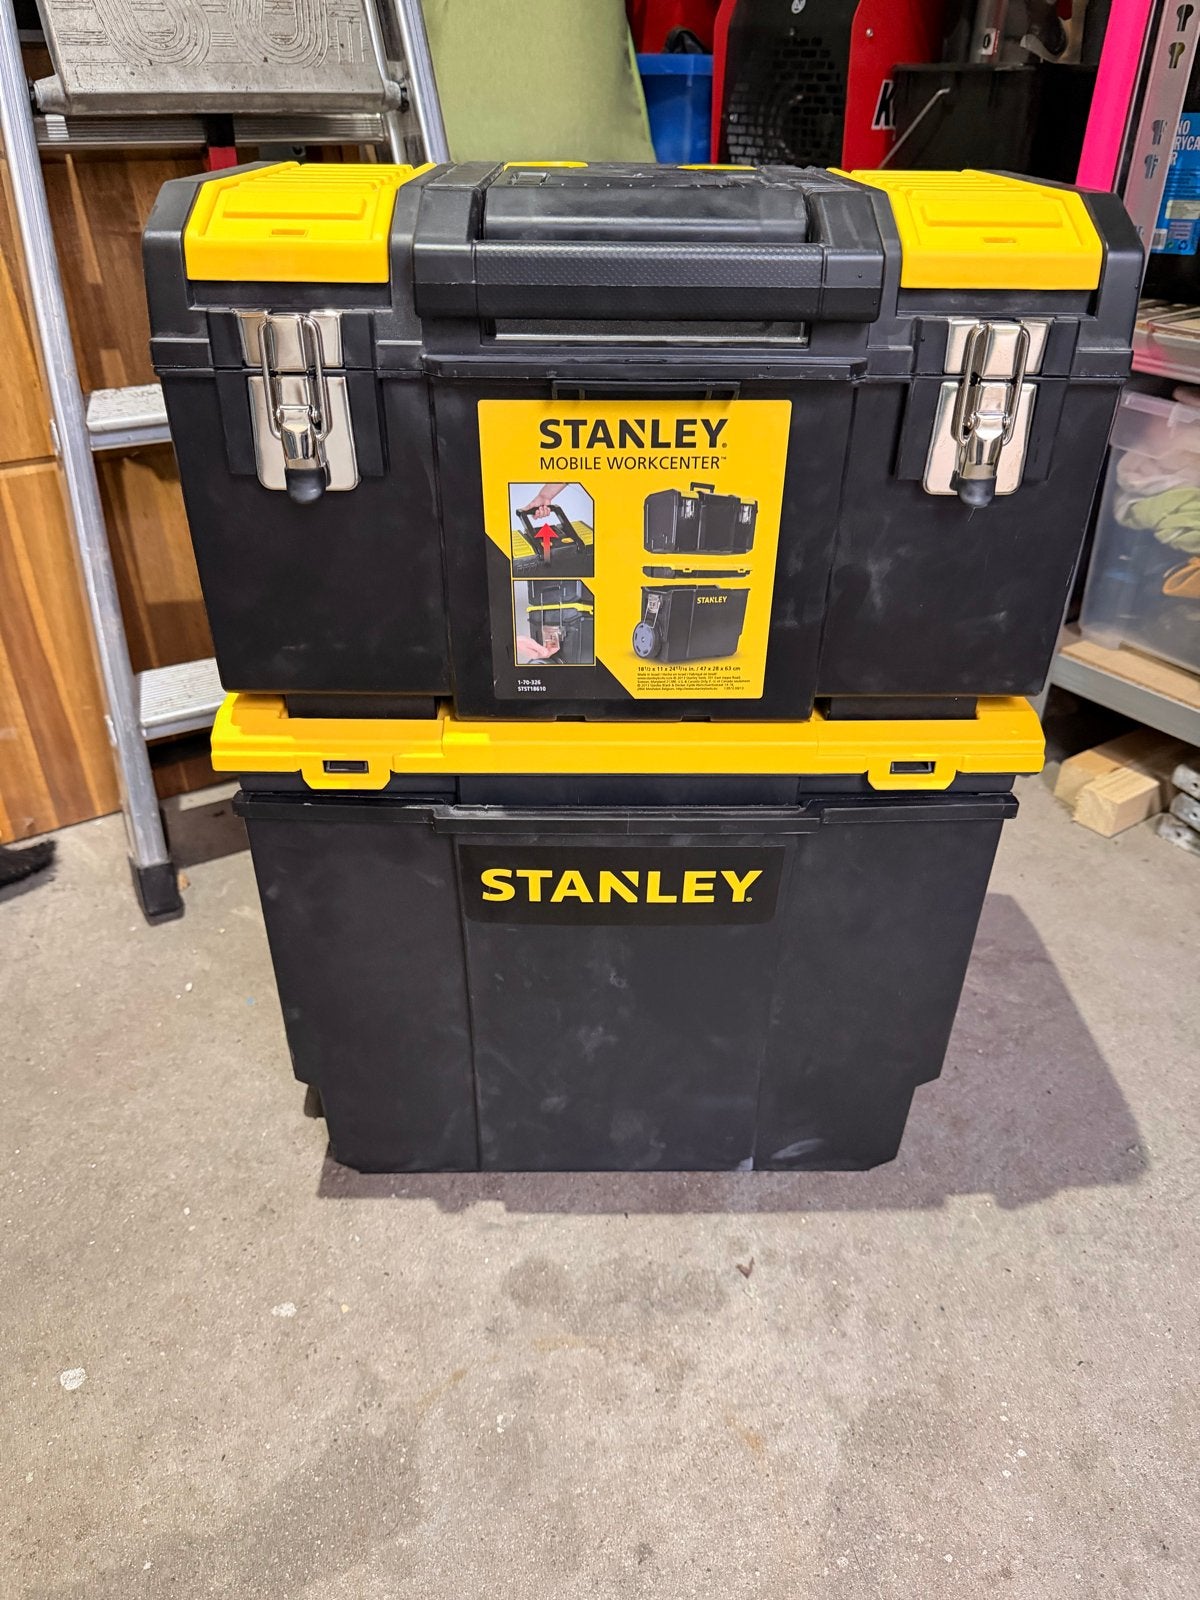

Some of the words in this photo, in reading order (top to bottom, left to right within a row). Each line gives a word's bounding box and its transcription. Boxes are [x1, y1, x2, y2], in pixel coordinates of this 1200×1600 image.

[871, 79, 896, 131] K
[540, 456, 602, 470] MOBILE
[696, 595, 728, 605] STANLEY
